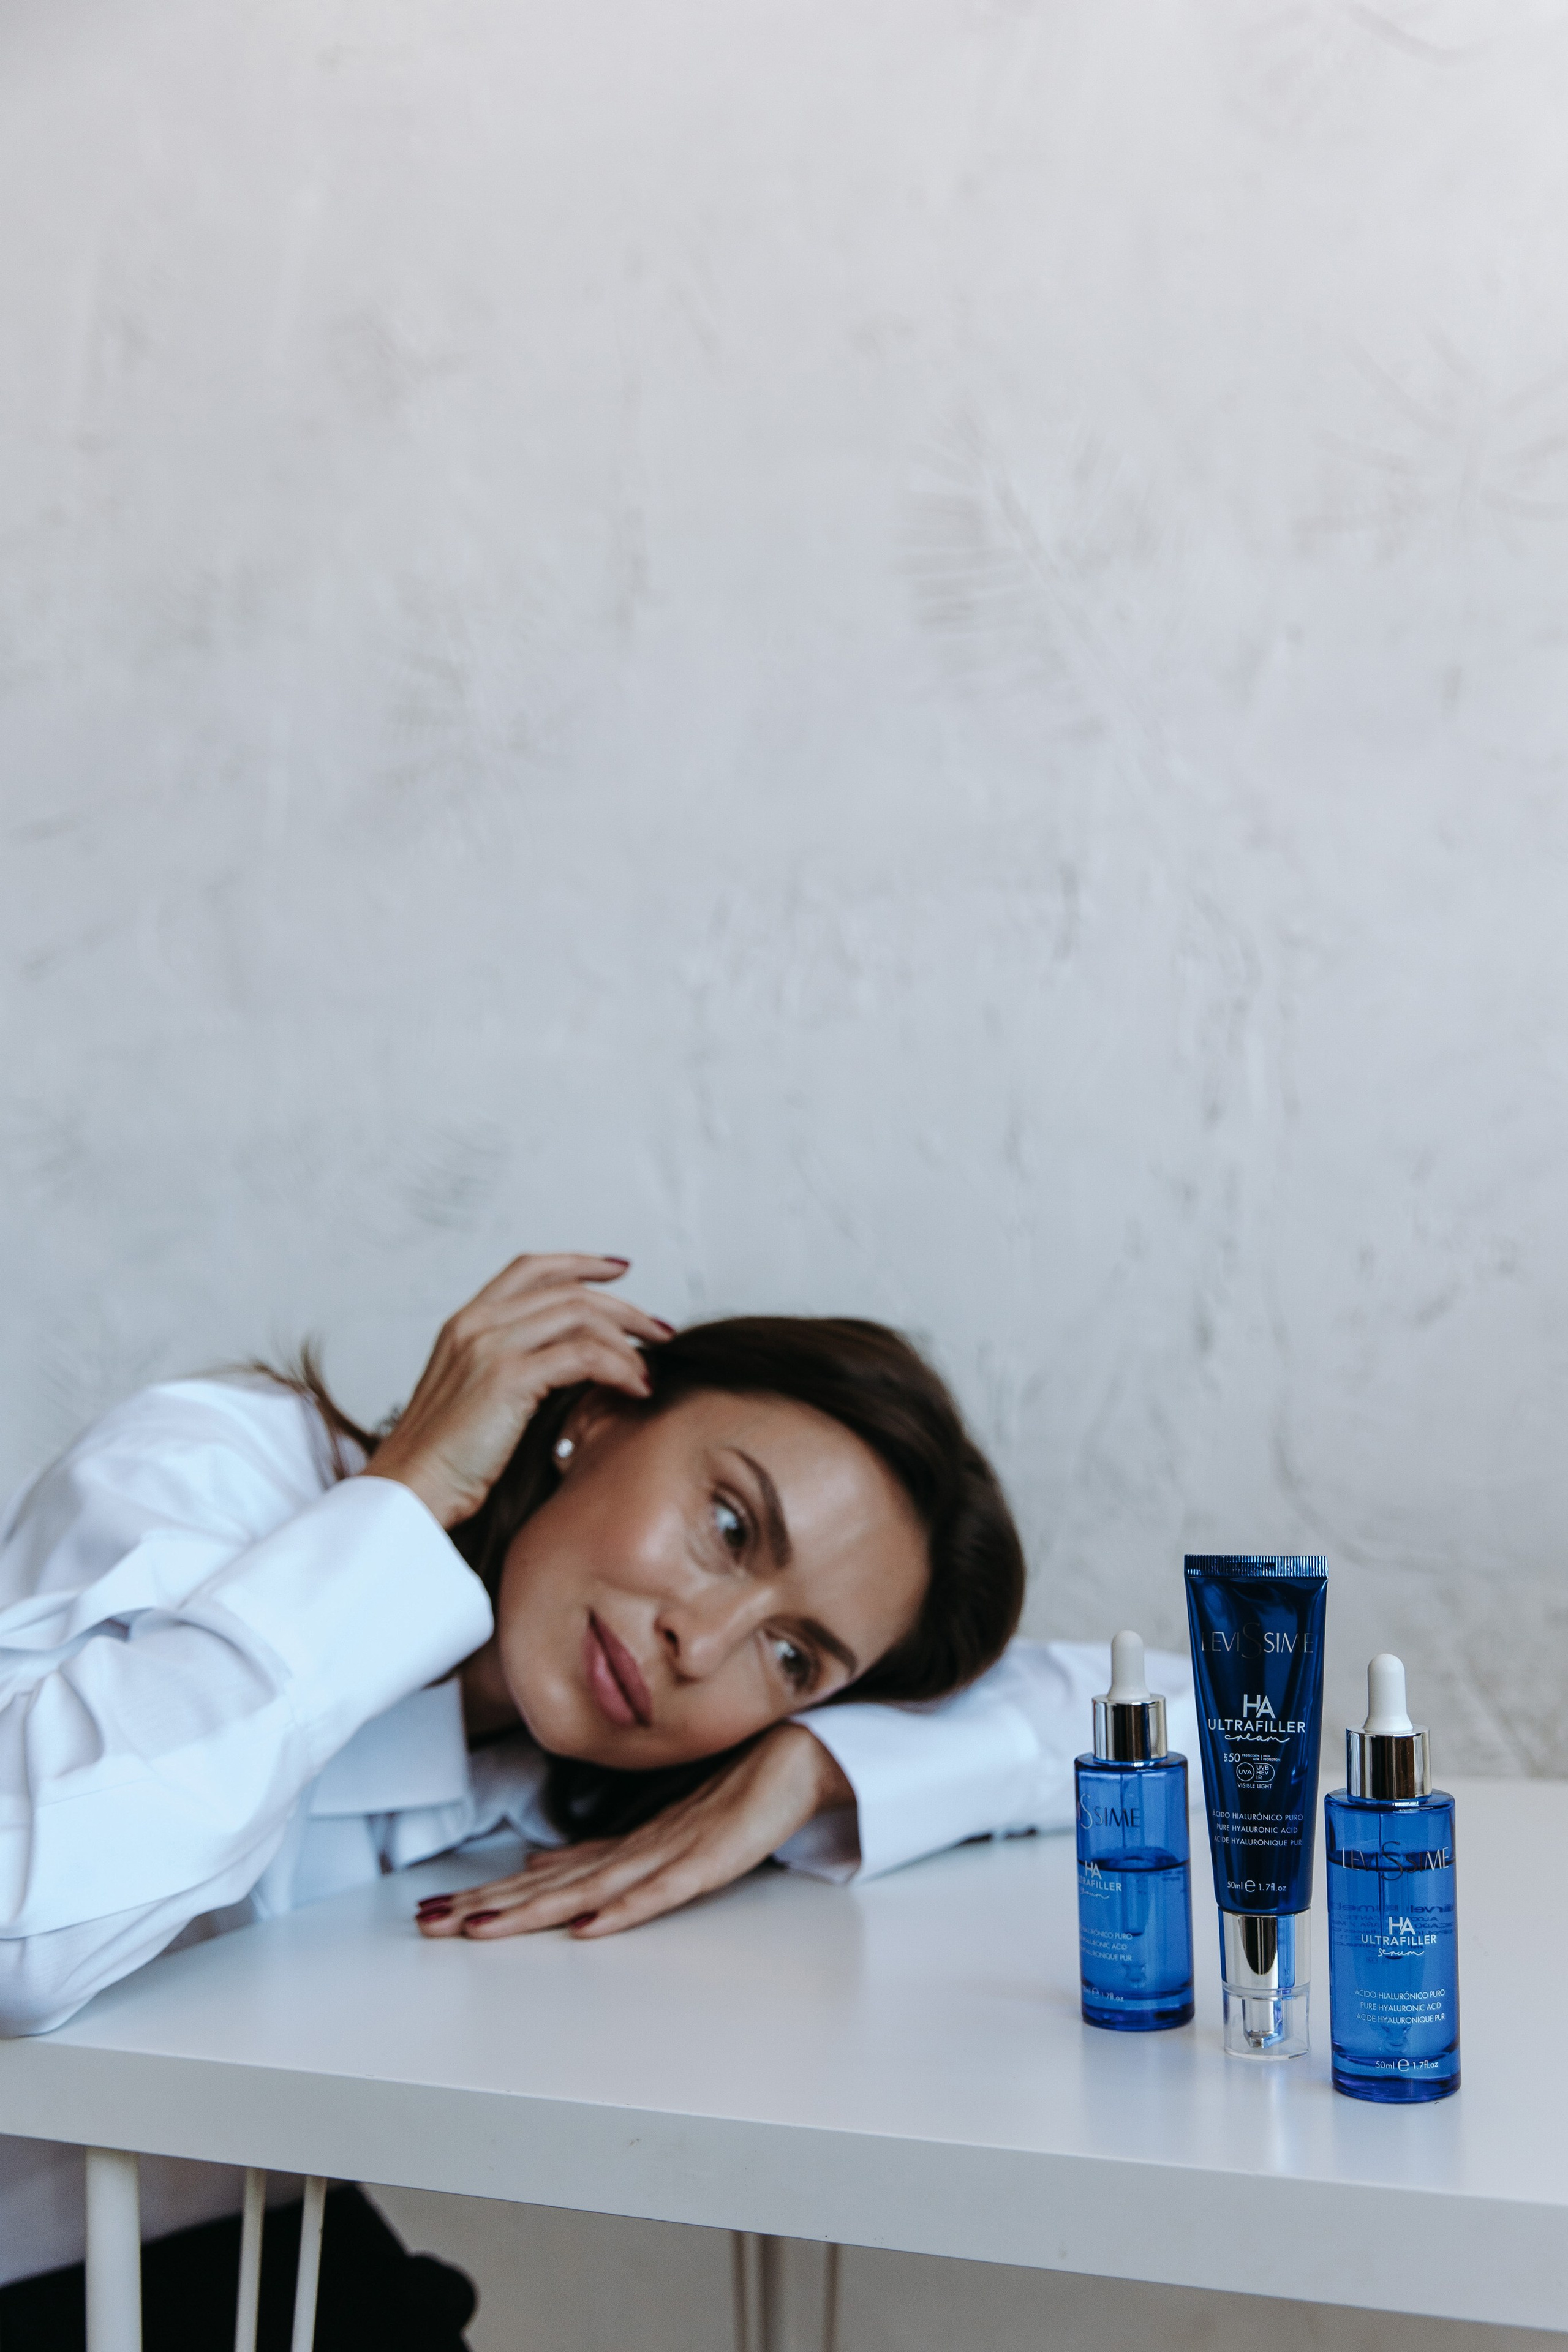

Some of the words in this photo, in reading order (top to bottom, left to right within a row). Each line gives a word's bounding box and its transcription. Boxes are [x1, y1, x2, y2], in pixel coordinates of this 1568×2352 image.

[1202, 1622, 1313, 1659] LEVISSIME
[1243, 1694, 1275, 1719] HA
[1208, 1719, 1306, 1733] ULTRAFILLER
[1225, 1733, 1290, 1743] cream
[1229, 1753, 1240, 1762] 50
[1213, 1809, 1230, 1818] ÁCIDO
[1343, 1841, 1449, 1880] LEVISSIME
[1085, 1860, 1102, 1879] HA
[1227, 1881, 1243, 1890] 50ml
[1389, 1917, 1415, 1935] HA
[1361, 1934, 1437, 1946] ULTRAFILLER
[1355, 1988, 1376, 1998] ÁCIDO
[1378, 1991, 1428, 2000] HIALURÓNICO
[1430, 1989, 1445, 1998] PURO
[1360, 2001, 1376, 2010] PURE
[1427, 2002, 1441, 2010] ACID
[1378, 2015, 1433, 2024] HYALURONIQUE
[1375, 2060, 1395, 2069] 50ml
